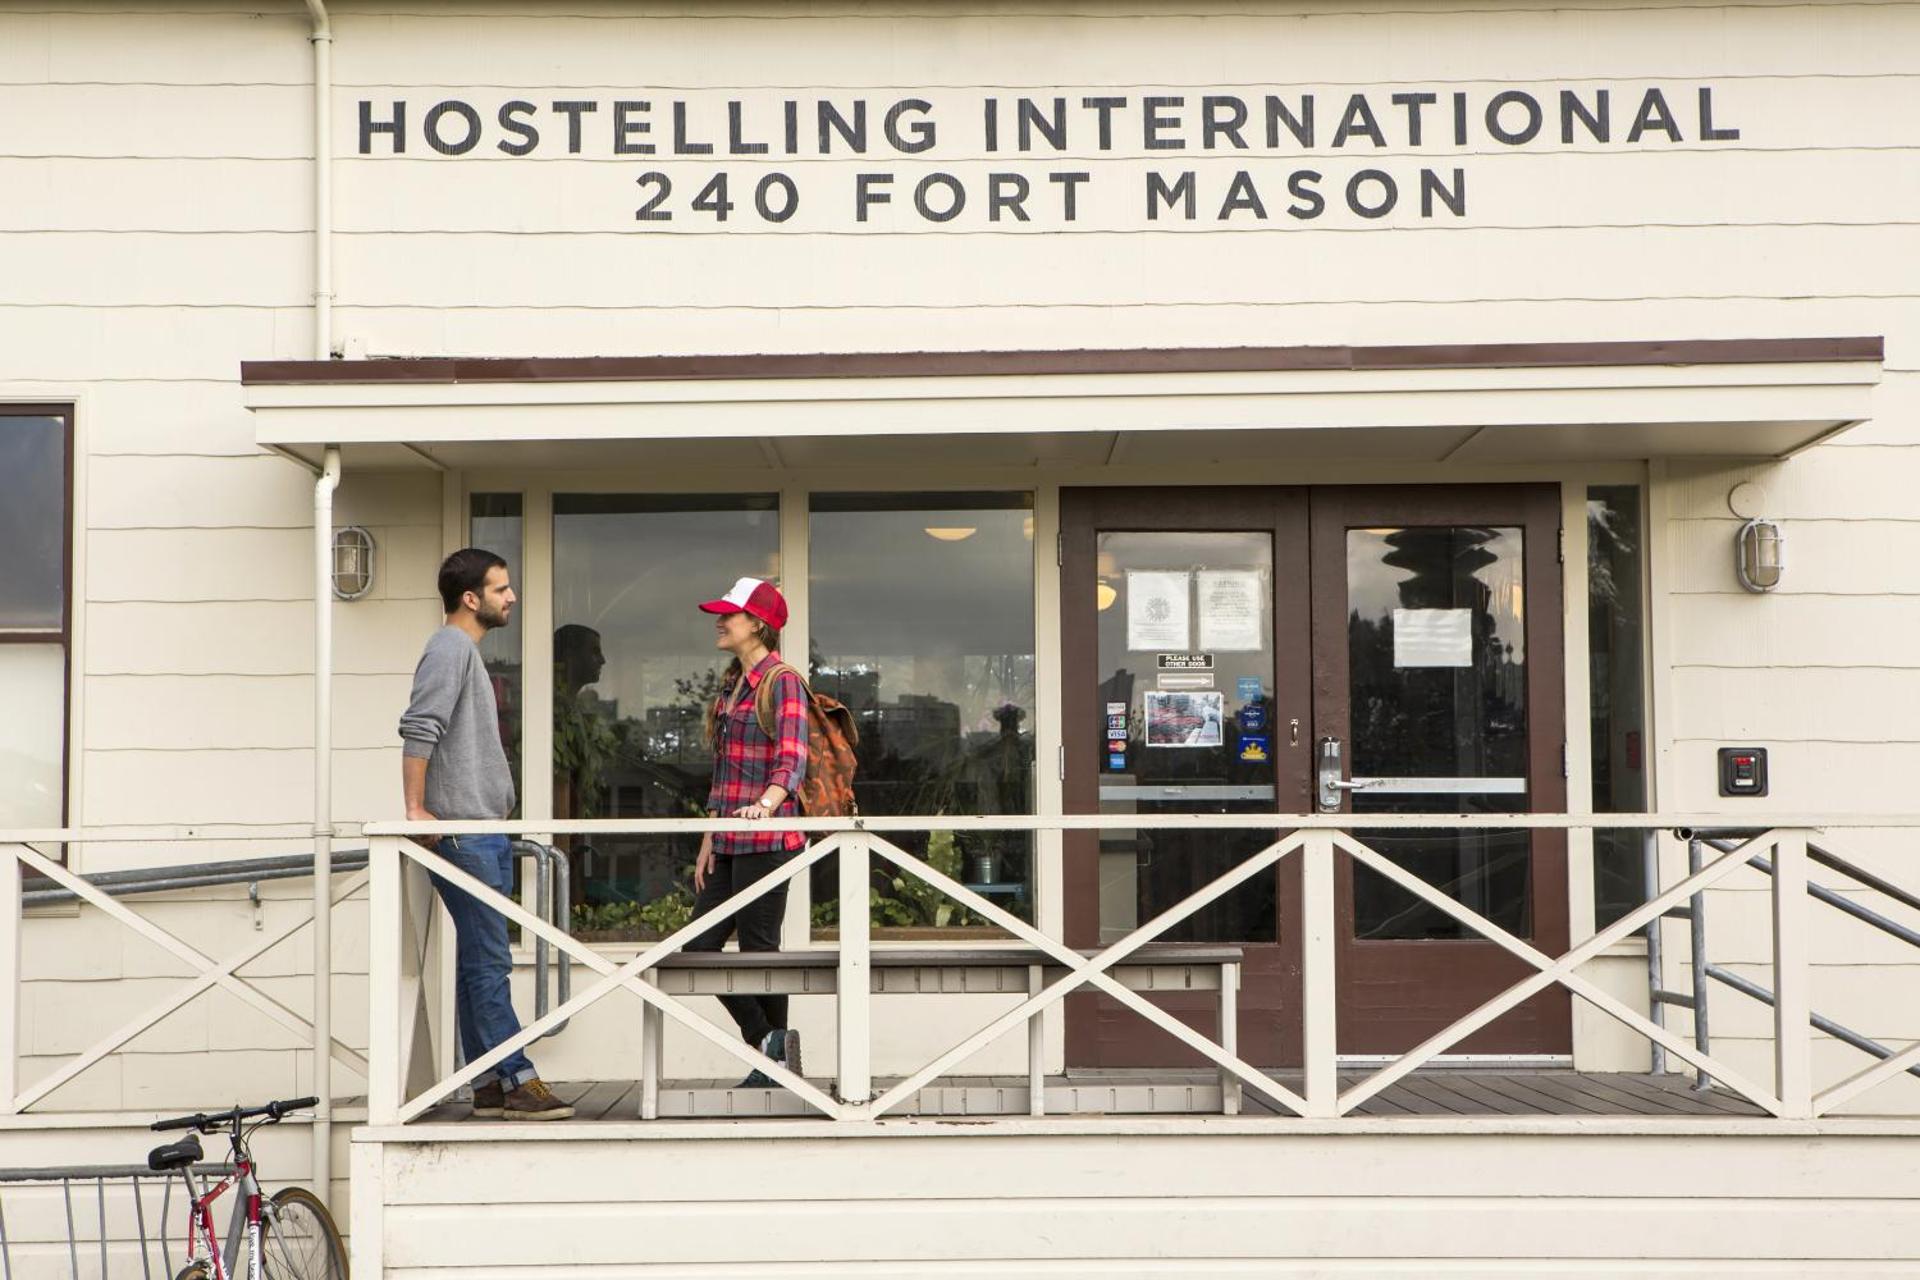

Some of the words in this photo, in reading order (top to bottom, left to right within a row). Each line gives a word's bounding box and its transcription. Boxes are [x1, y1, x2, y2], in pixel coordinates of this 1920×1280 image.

[358, 100, 937, 156] HOSTELLING
[985, 88, 1740, 153] INTERNATIONAL
[636, 172, 799, 223] 240
[856, 172, 1090, 222] FORT
[1146, 169, 1465, 220] MASON
